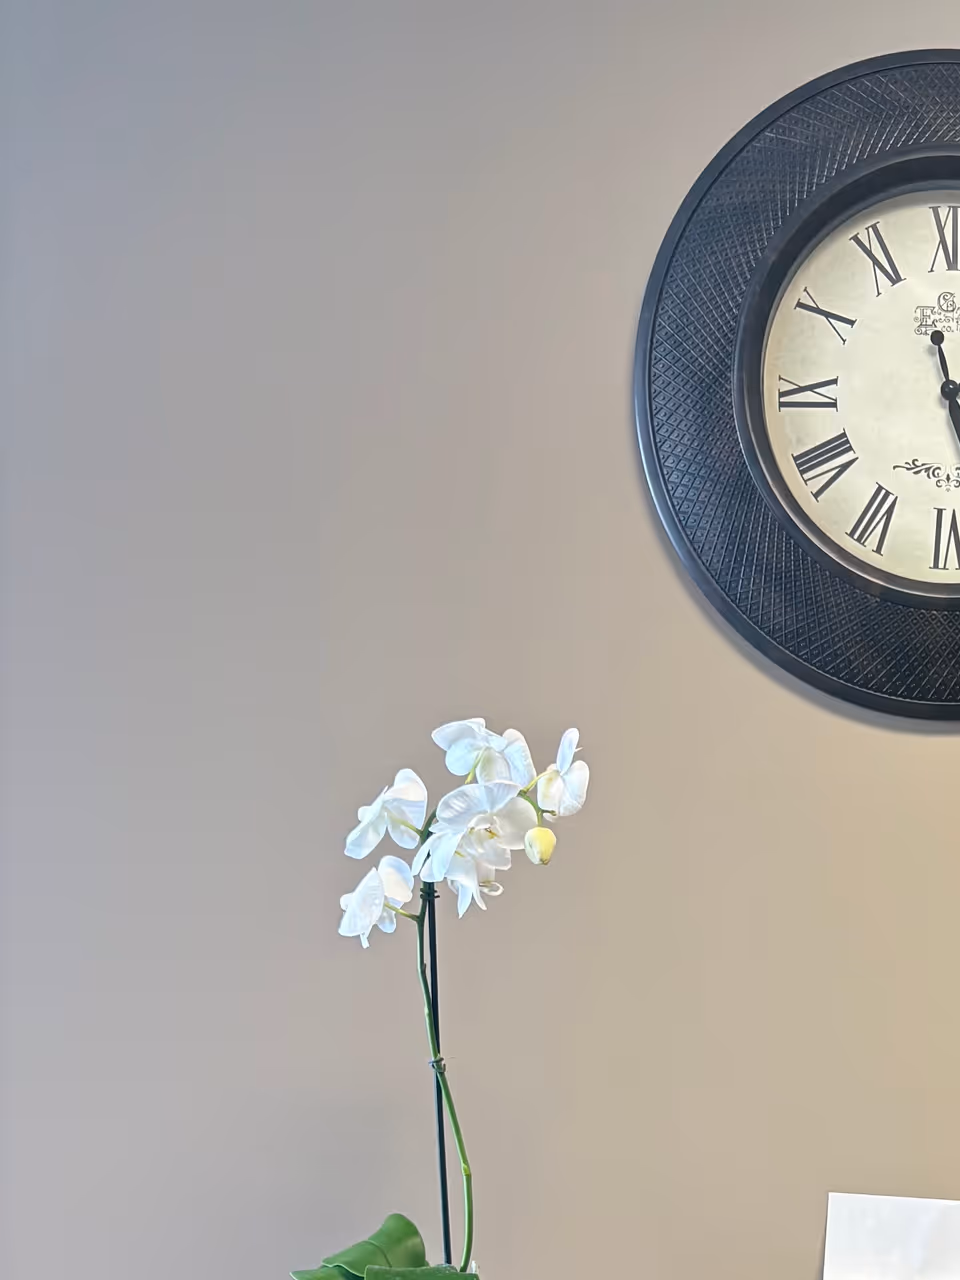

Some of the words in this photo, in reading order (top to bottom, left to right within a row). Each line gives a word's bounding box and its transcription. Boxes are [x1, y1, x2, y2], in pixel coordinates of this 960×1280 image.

[849, 221, 907, 298] XI
[794, 286, 857, 345] X
[778, 374, 839, 413] IX
[791, 427, 860, 503] VIII
[844, 481, 899, 557] VII
